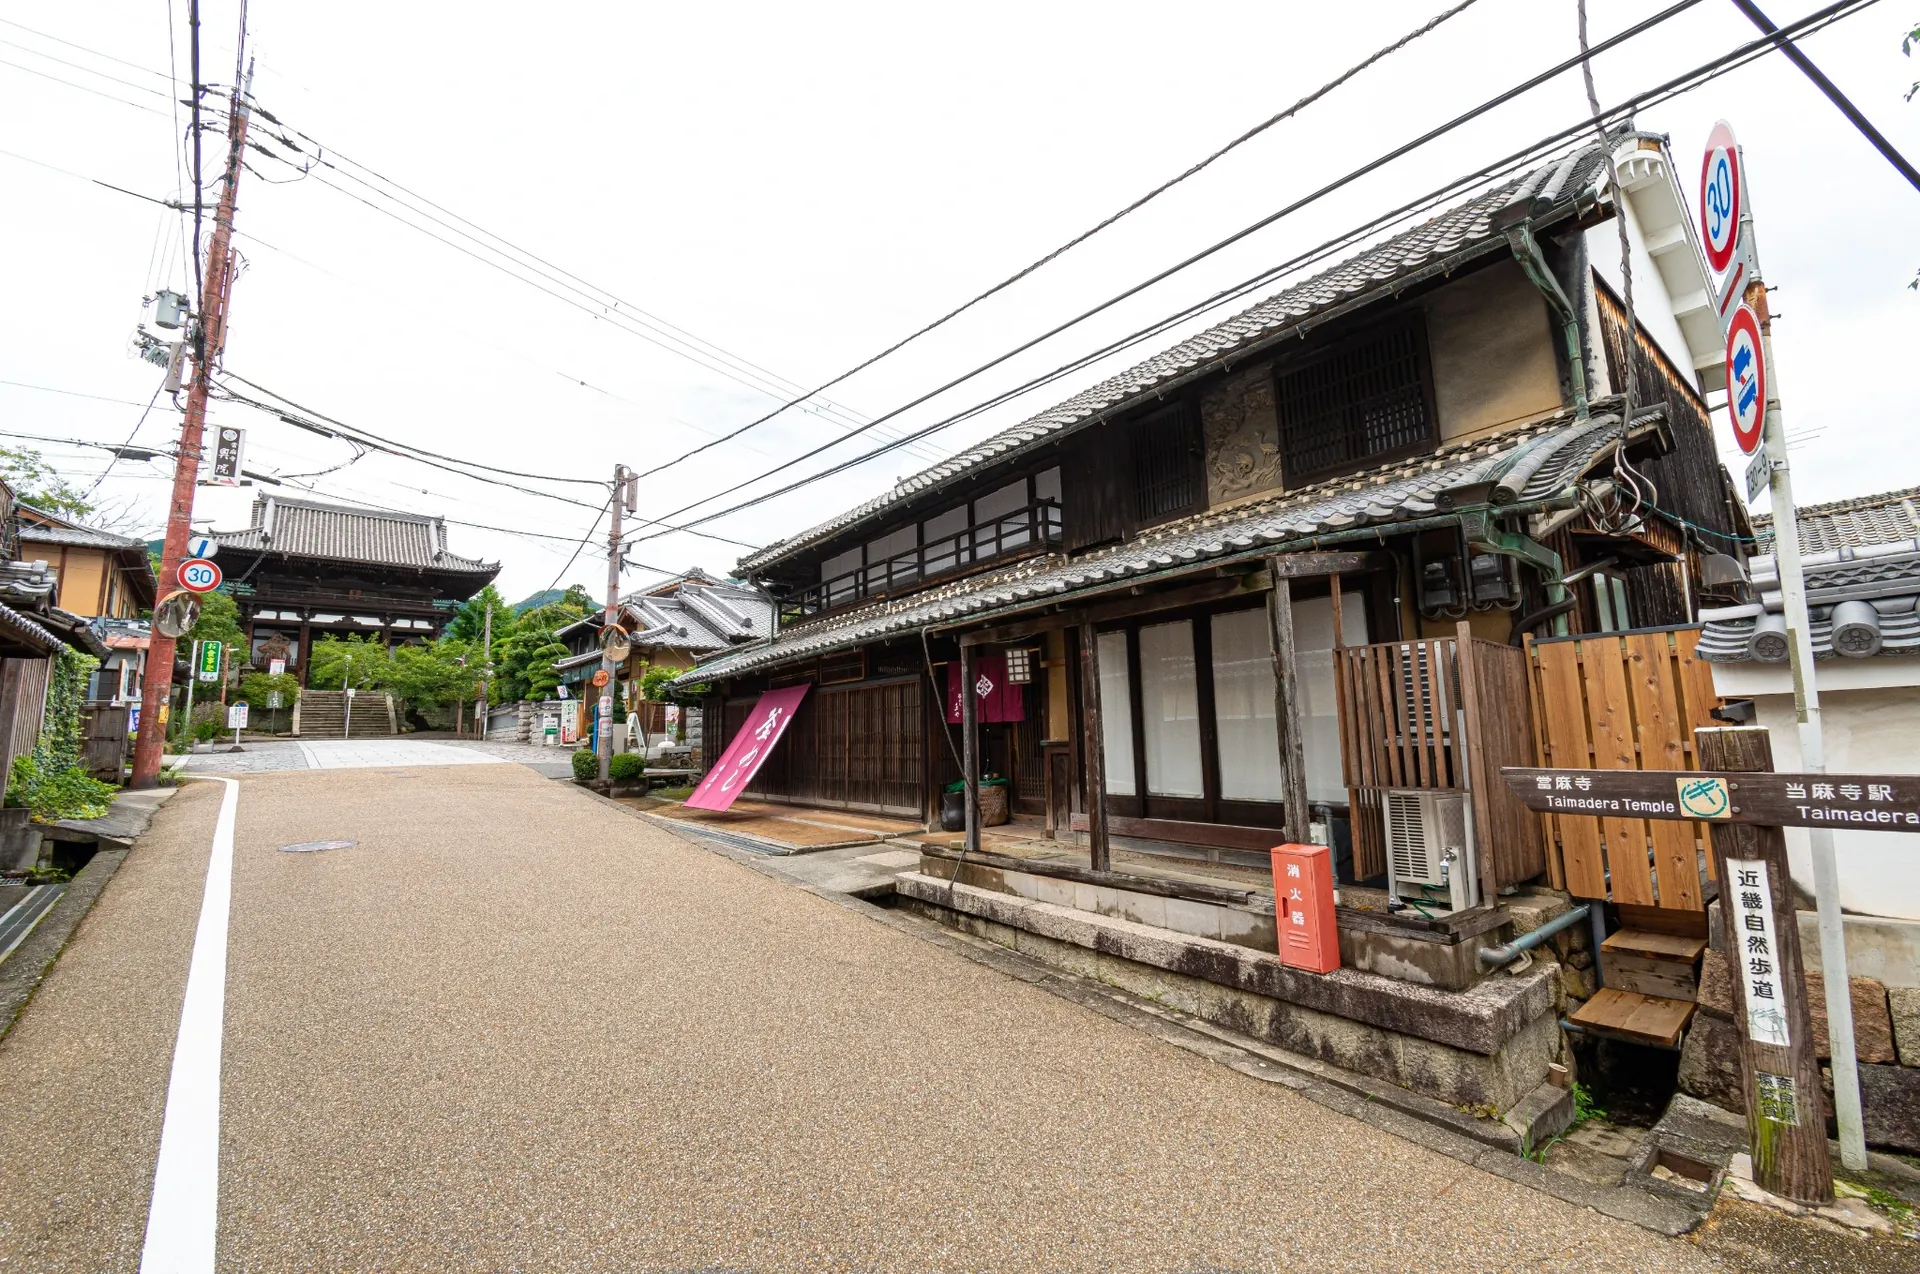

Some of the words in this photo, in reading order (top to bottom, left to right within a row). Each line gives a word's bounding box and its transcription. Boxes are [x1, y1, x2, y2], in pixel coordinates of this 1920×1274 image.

[1707, 158, 1731, 240] 30
[187, 567, 212, 584] 30
[1536, 775, 1592, 791] 當麻寺
[1785, 782, 1894, 802] 当麻寺駅
[1546, 795, 1619, 810] Taimadera
[1622, 798, 1675, 813] Temple
[1796, 805, 1920, 824] Taimadera
[1286, 863, 1305, 926] 消火器
[1737, 869, 1775, 1000] 近畿自然歩道
